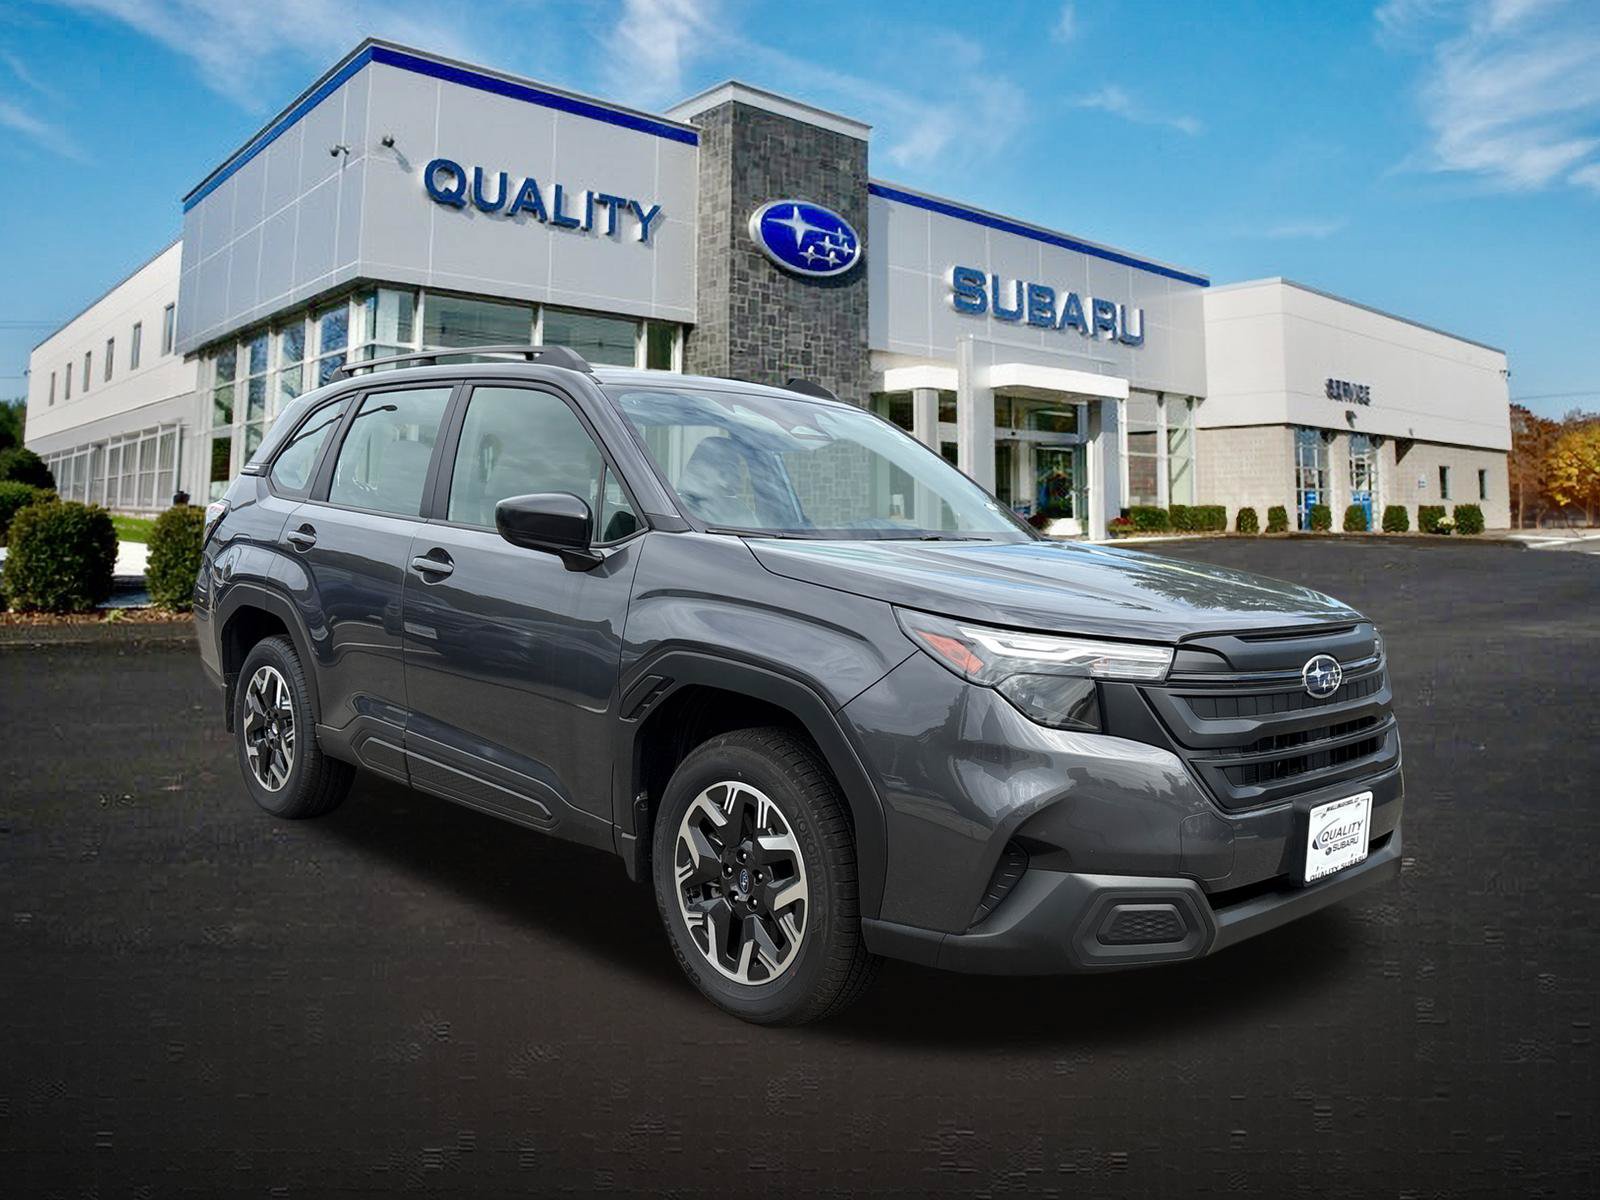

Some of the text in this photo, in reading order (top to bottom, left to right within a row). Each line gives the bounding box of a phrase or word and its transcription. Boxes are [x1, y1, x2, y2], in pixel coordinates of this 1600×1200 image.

[424, 158, 661, 242] QUALITY
[949, 265, 1145, 347] SUBARU
[1321, 819, 1363, 843] QUALITY
[1332, 836, 1359, 852] SUBARU
